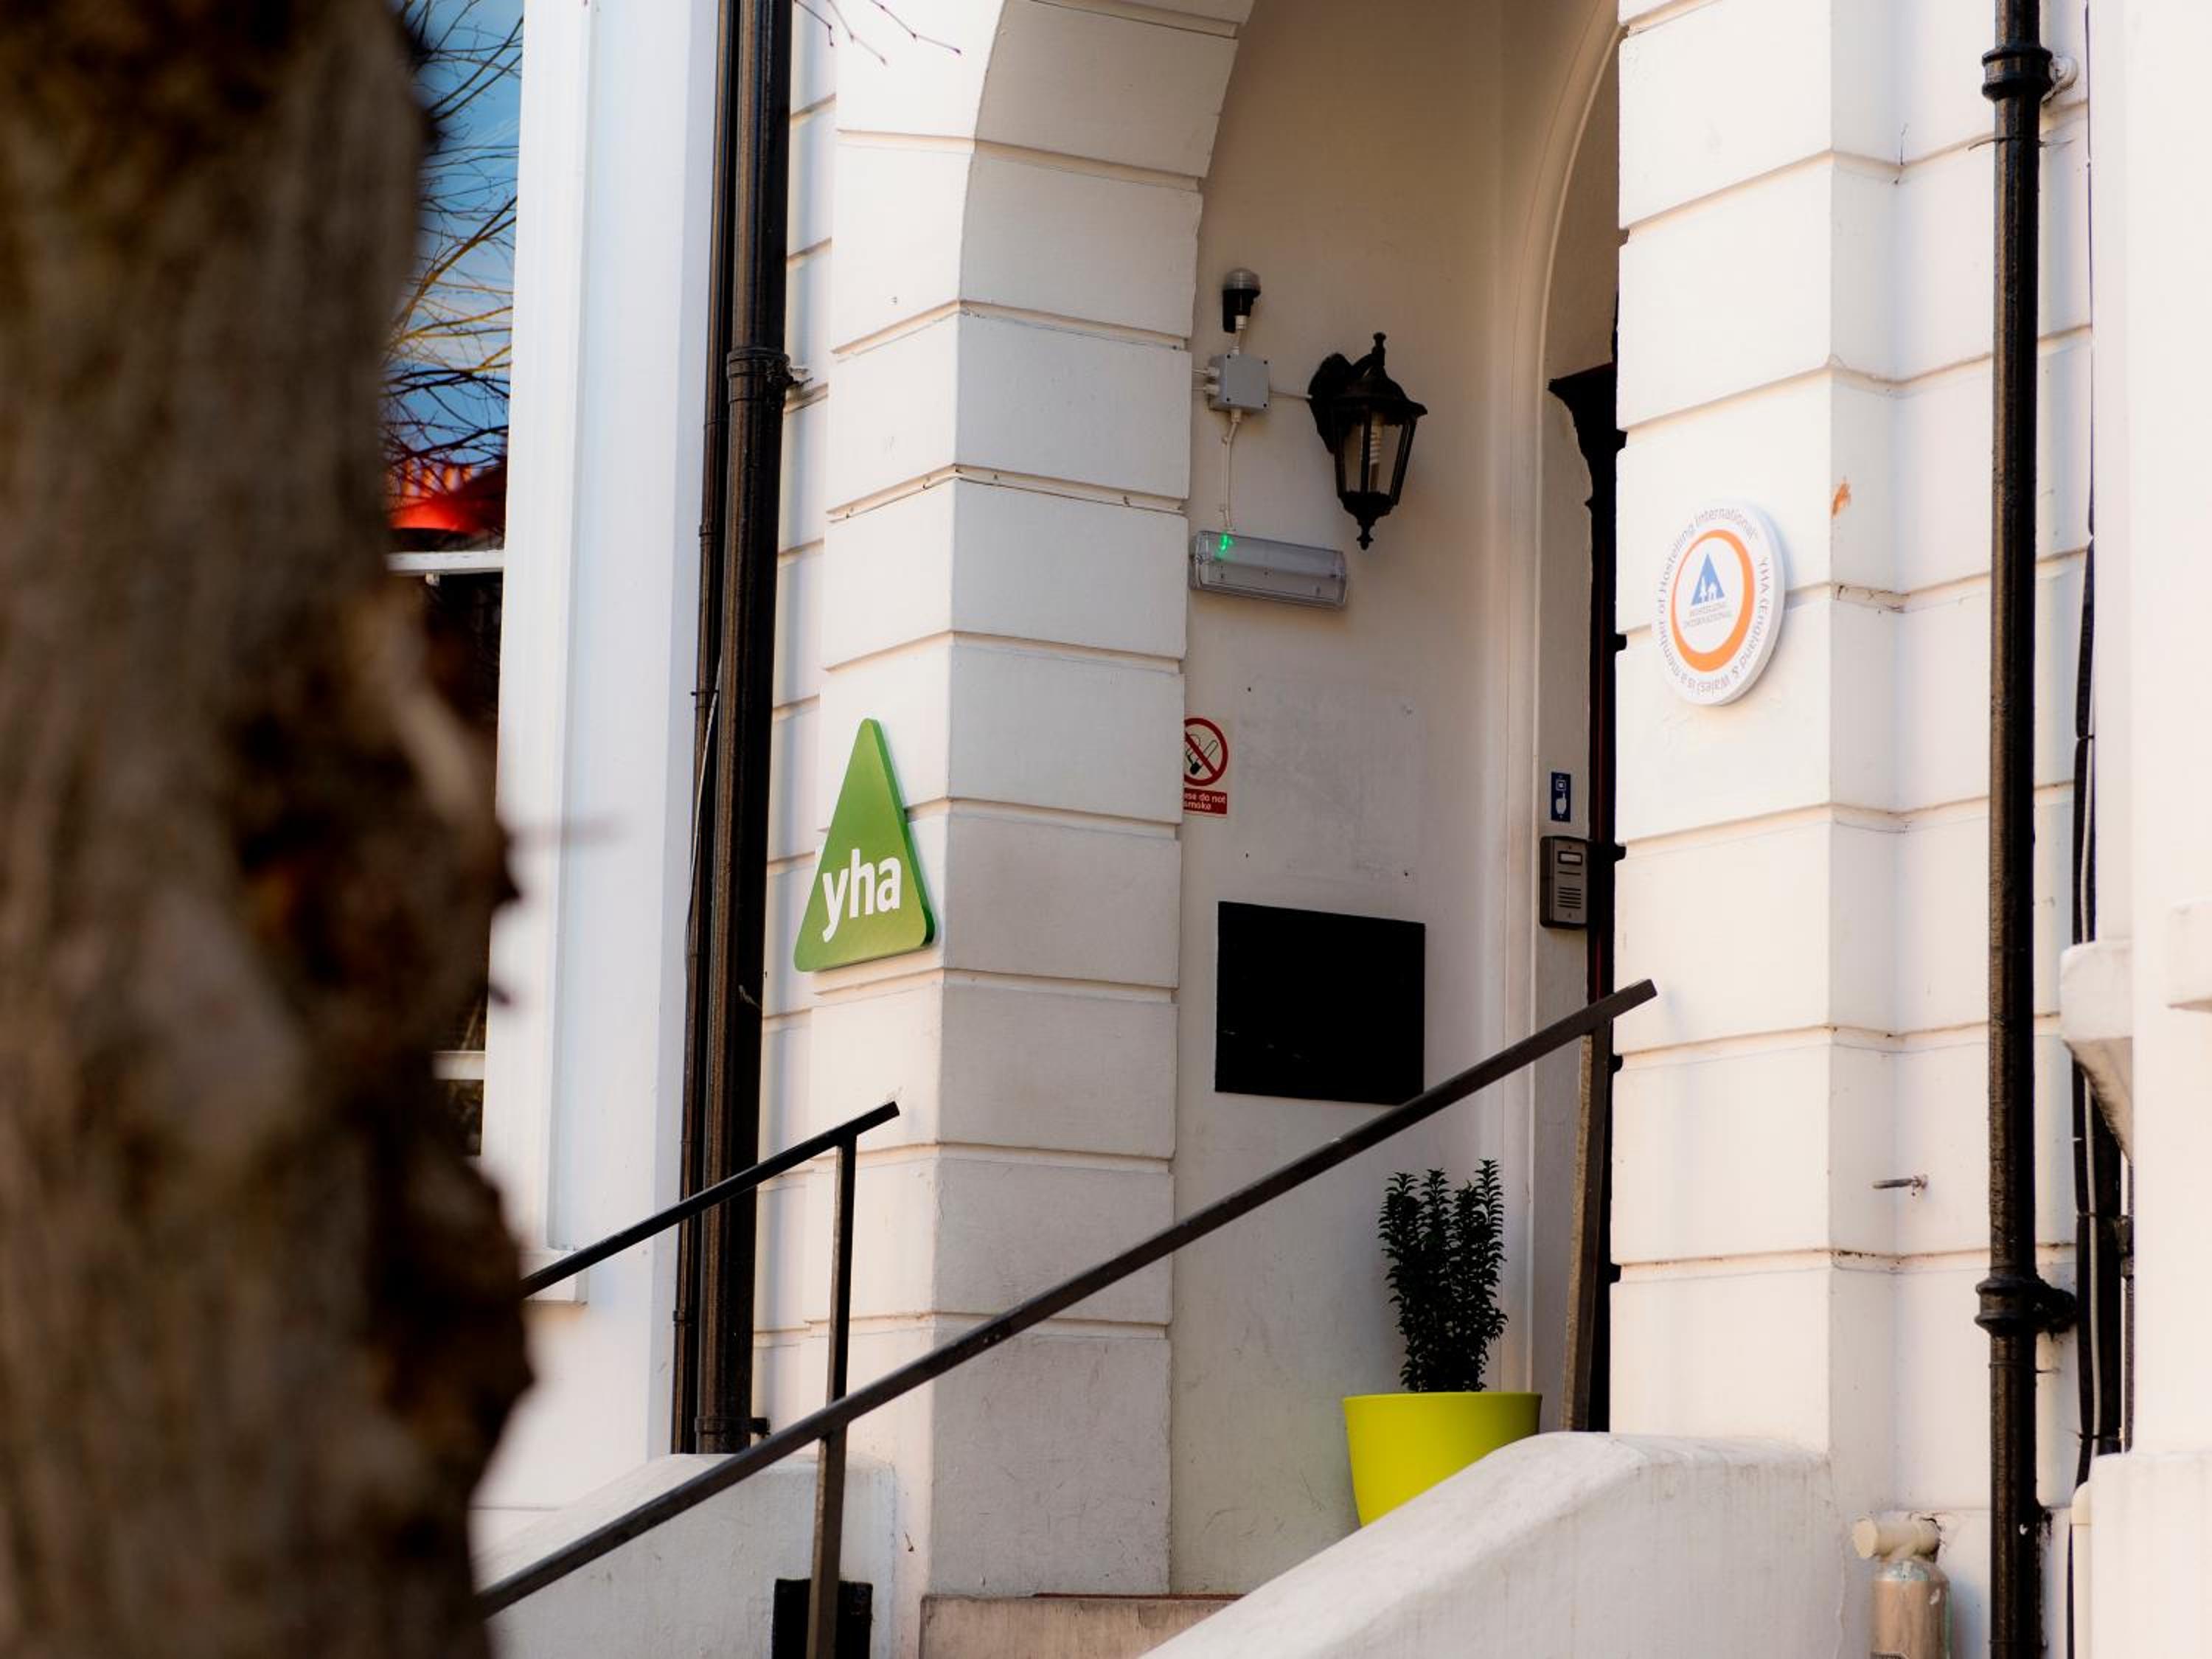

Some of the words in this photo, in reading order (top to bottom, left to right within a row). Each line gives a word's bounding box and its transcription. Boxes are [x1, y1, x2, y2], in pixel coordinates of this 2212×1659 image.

[1199, 793, 1210, 801] do
[1211, 795, 1226, 804] not
[822, 849, 901, 942] yha
